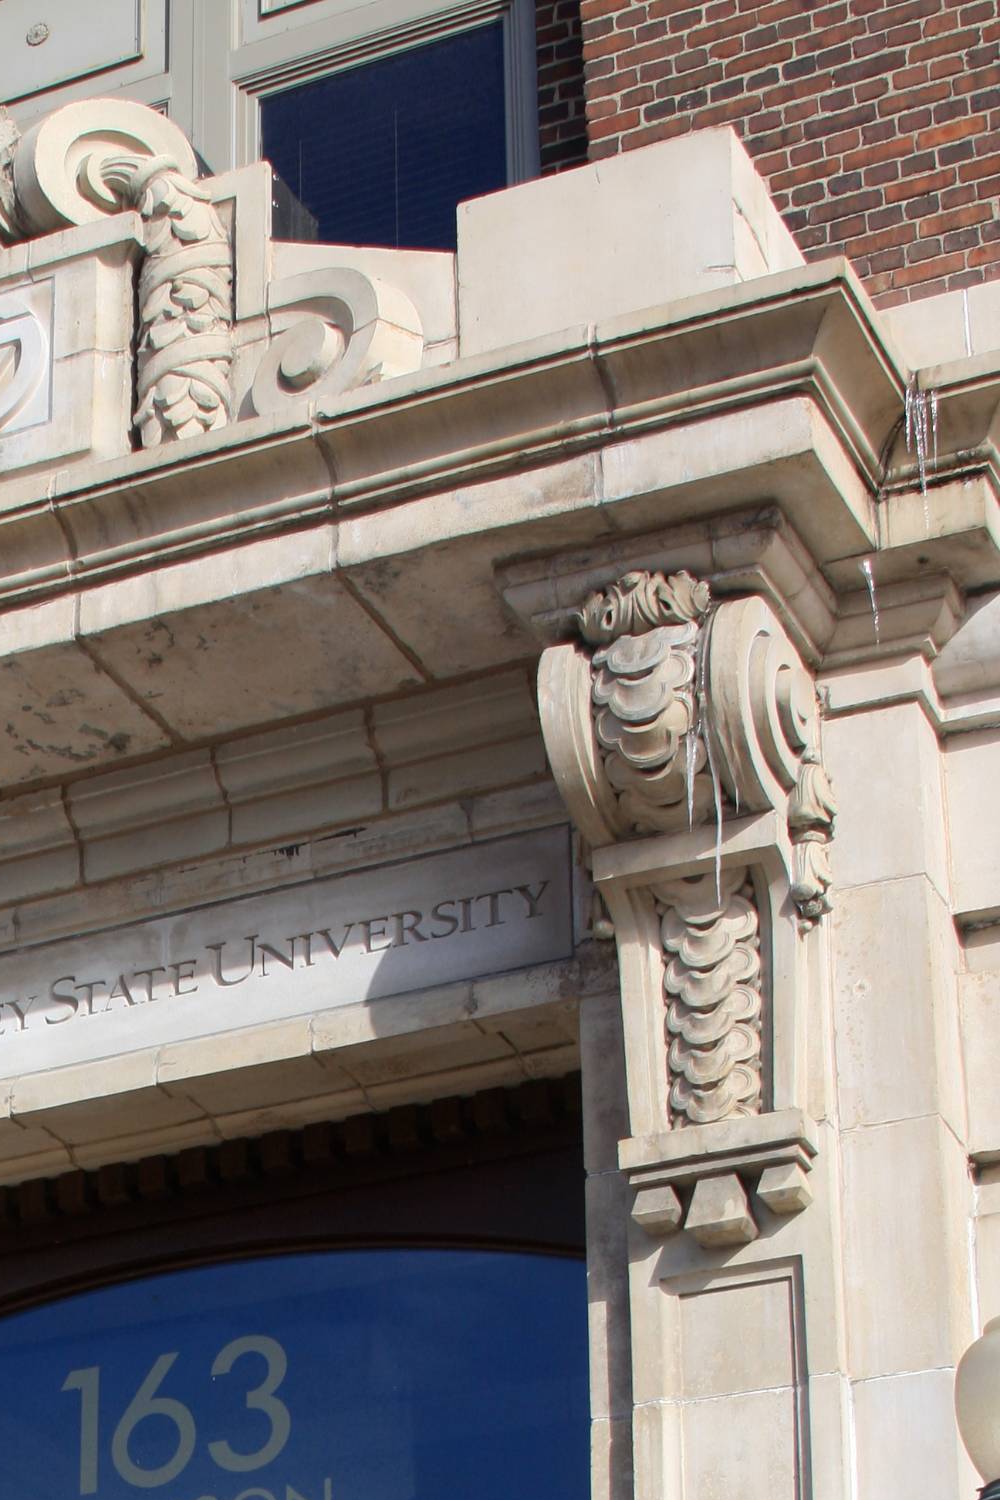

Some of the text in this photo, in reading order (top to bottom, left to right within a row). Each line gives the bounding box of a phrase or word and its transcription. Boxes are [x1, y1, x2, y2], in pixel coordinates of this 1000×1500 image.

[44, 959, 200, 1026] STATE
[205, 880, 551, 987] UNIVERSITY
[61, 1335, 291, 1496] 163
